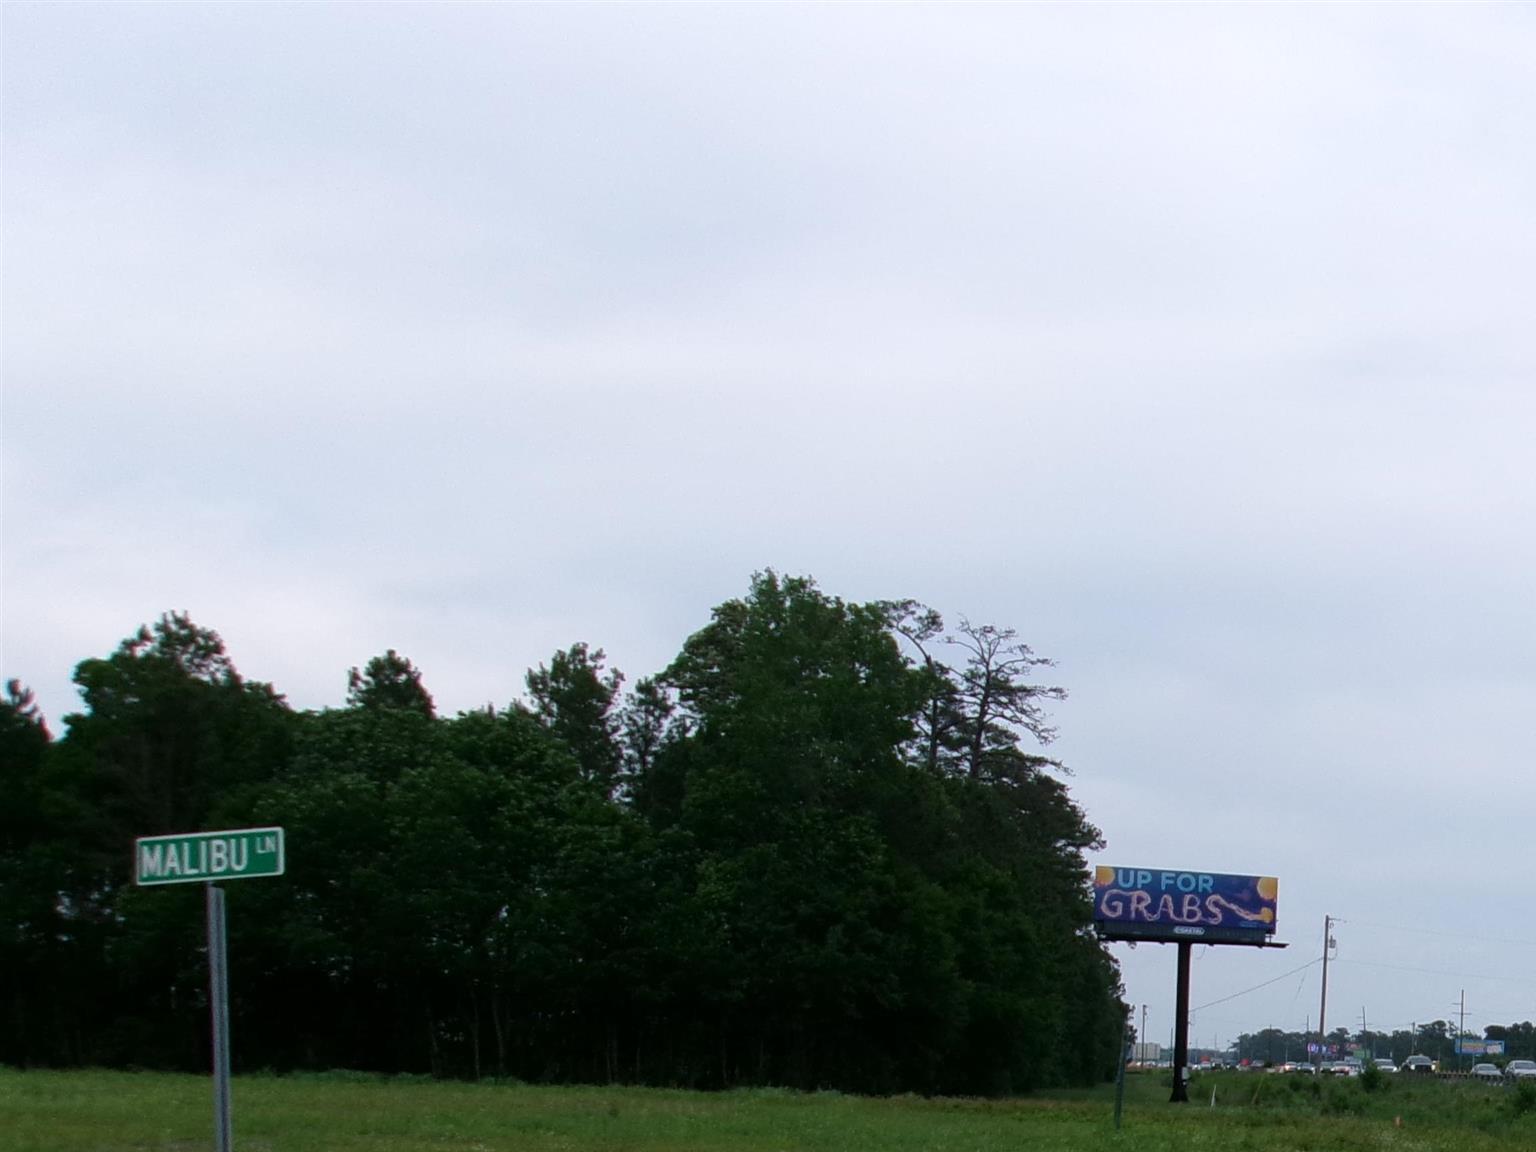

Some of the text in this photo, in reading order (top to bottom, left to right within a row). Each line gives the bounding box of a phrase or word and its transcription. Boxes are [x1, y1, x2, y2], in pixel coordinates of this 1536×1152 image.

[142, 836, 276, 877] MALIBU LN
[1118, 869, 1214, 893] UP FOR
[1100, 889, 1222, 925] GRABS
